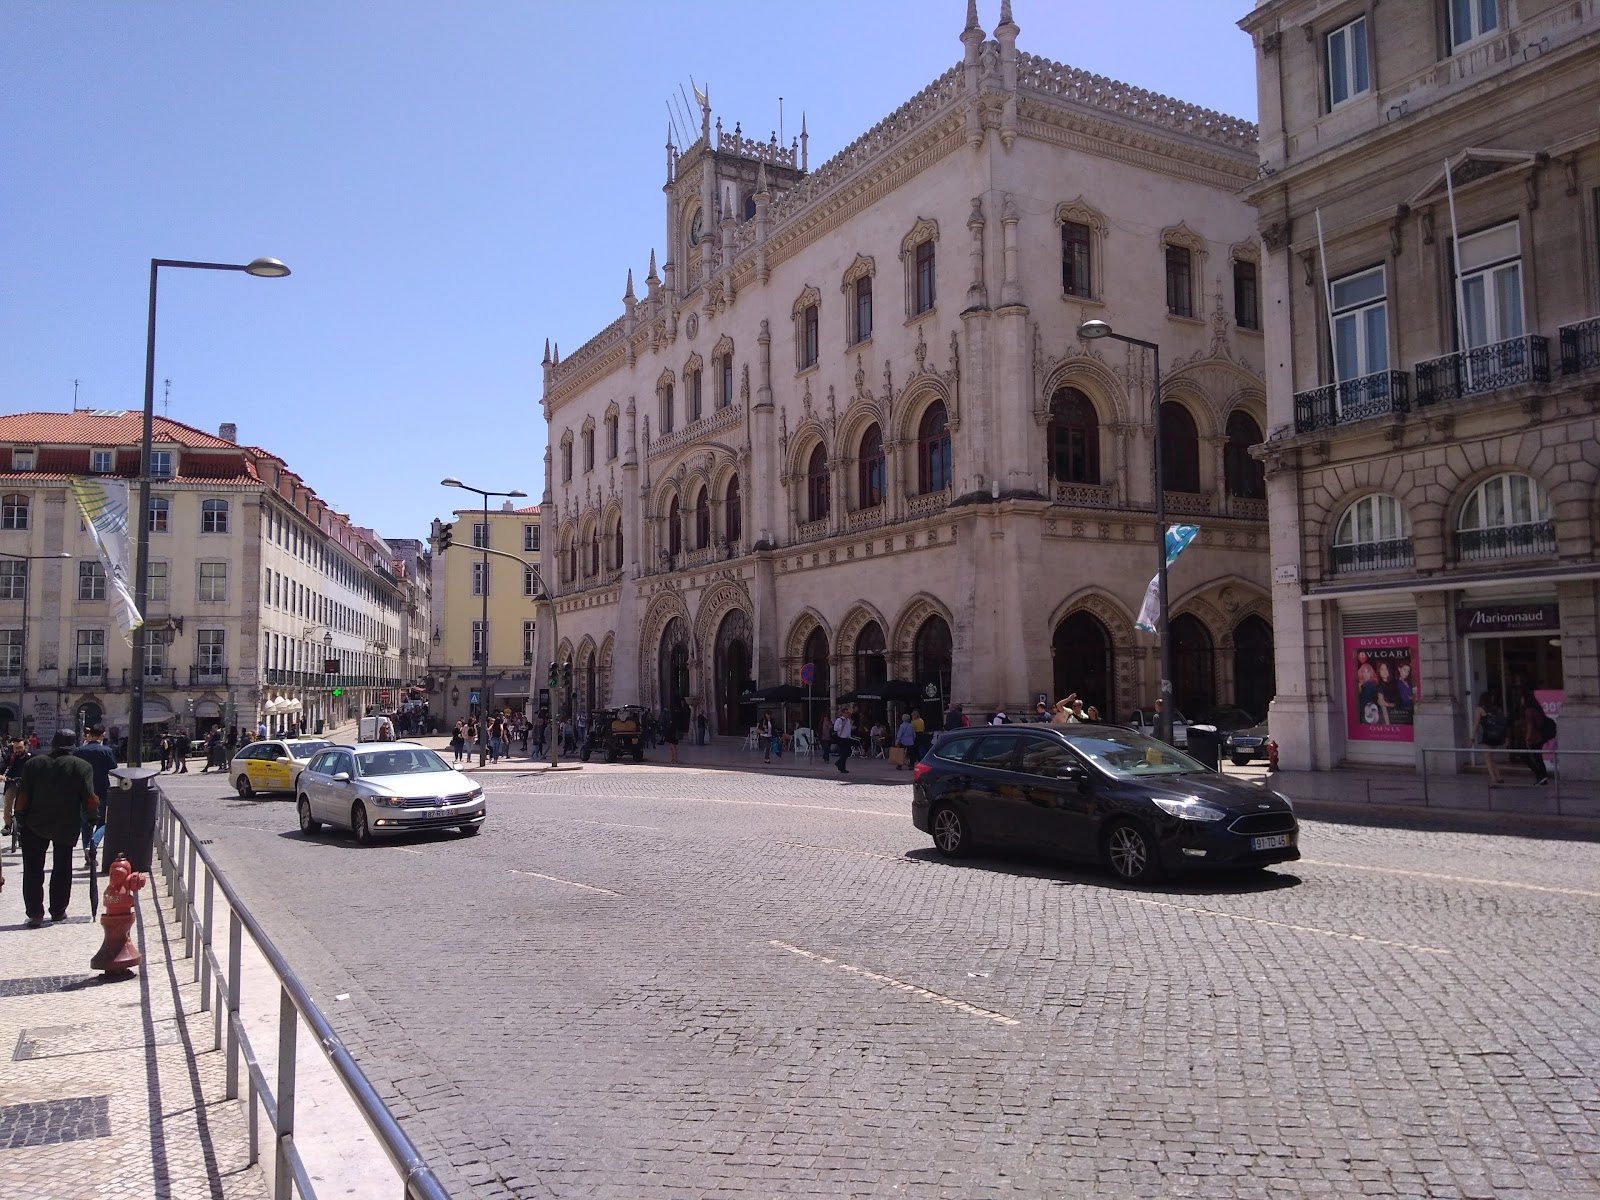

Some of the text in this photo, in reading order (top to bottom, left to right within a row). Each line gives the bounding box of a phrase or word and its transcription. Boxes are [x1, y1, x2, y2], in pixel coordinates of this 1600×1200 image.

[1469, 609, 1543, 627] Marionnaud
[1360, 636, 1408, 646] BVLGARI
[1359, 650, 1409, 658] BVLGARI
